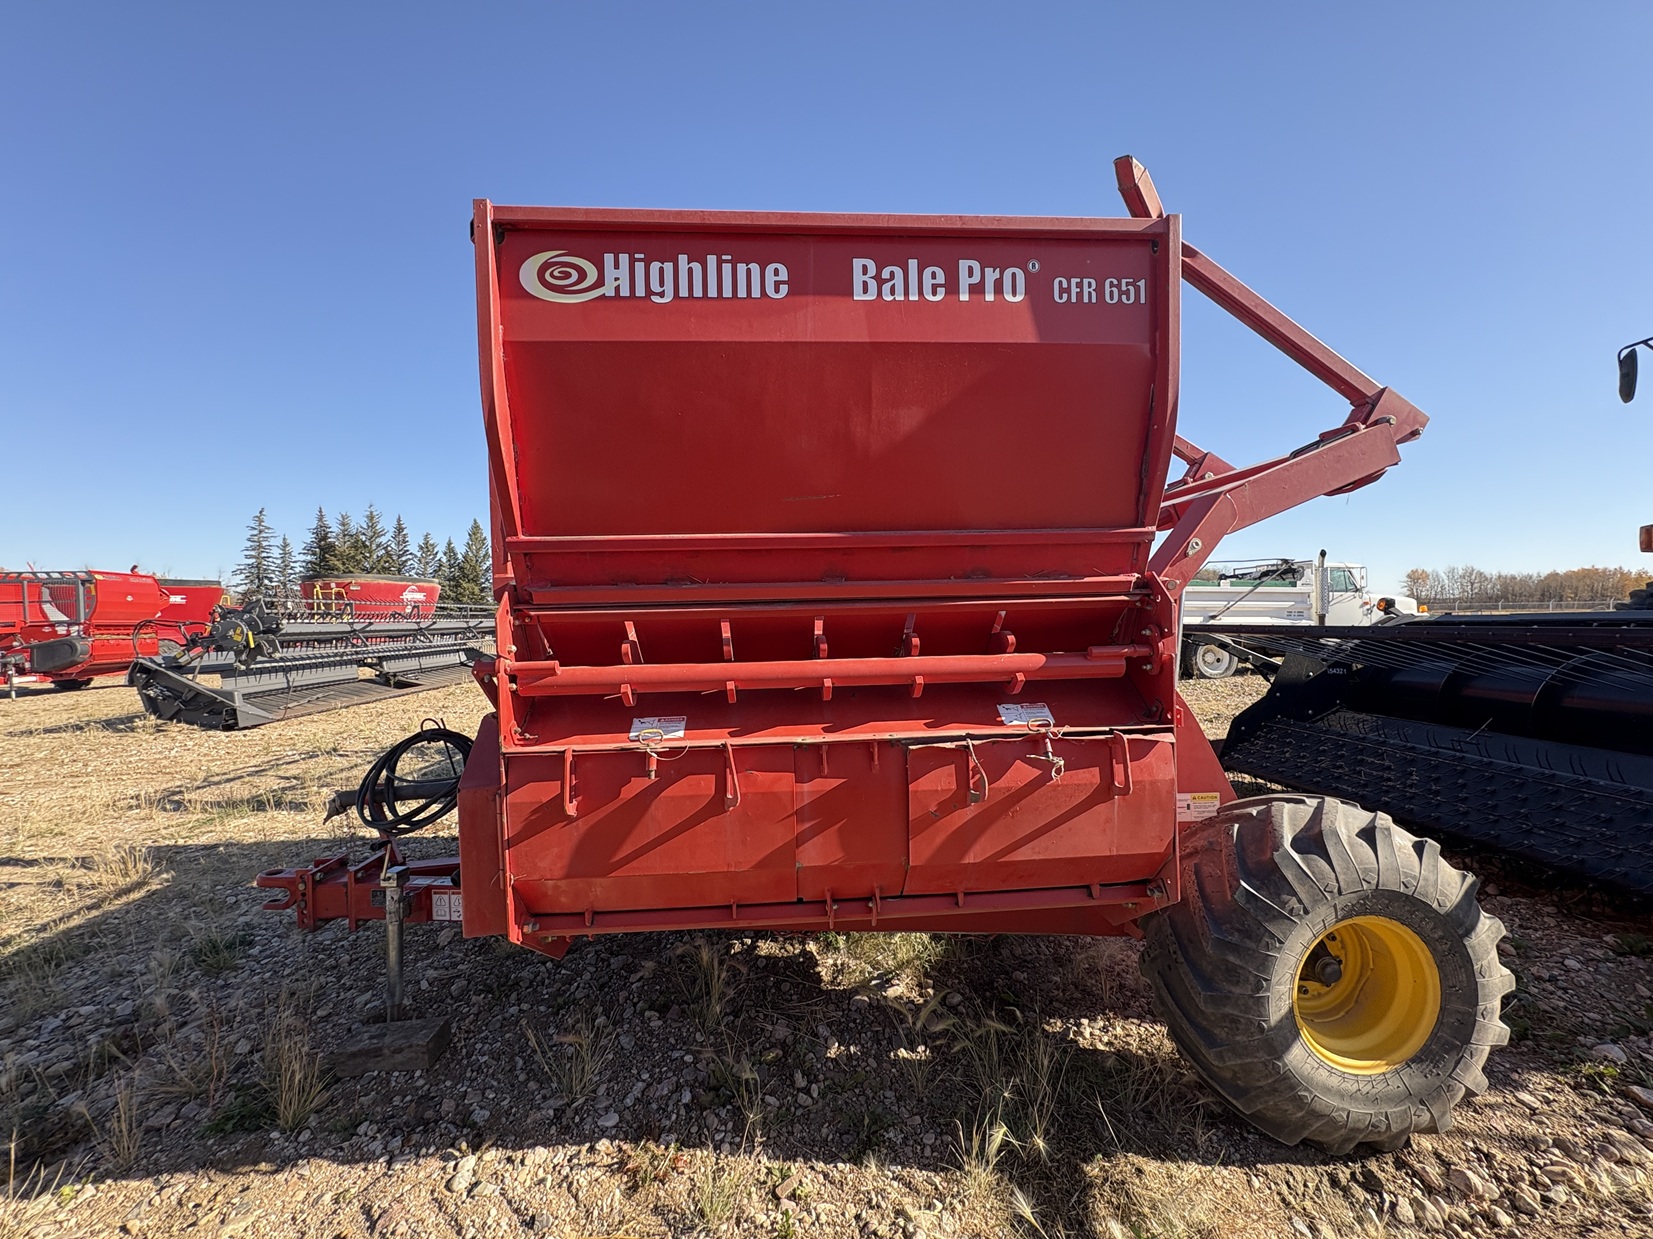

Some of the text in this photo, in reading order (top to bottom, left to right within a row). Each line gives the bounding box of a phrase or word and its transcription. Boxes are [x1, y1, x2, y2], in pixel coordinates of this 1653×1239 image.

[602, 252, 790, 304] Highline
[851, 257, 946, 302] Bale
[1053, 276, 1147, 305] CFR 651
